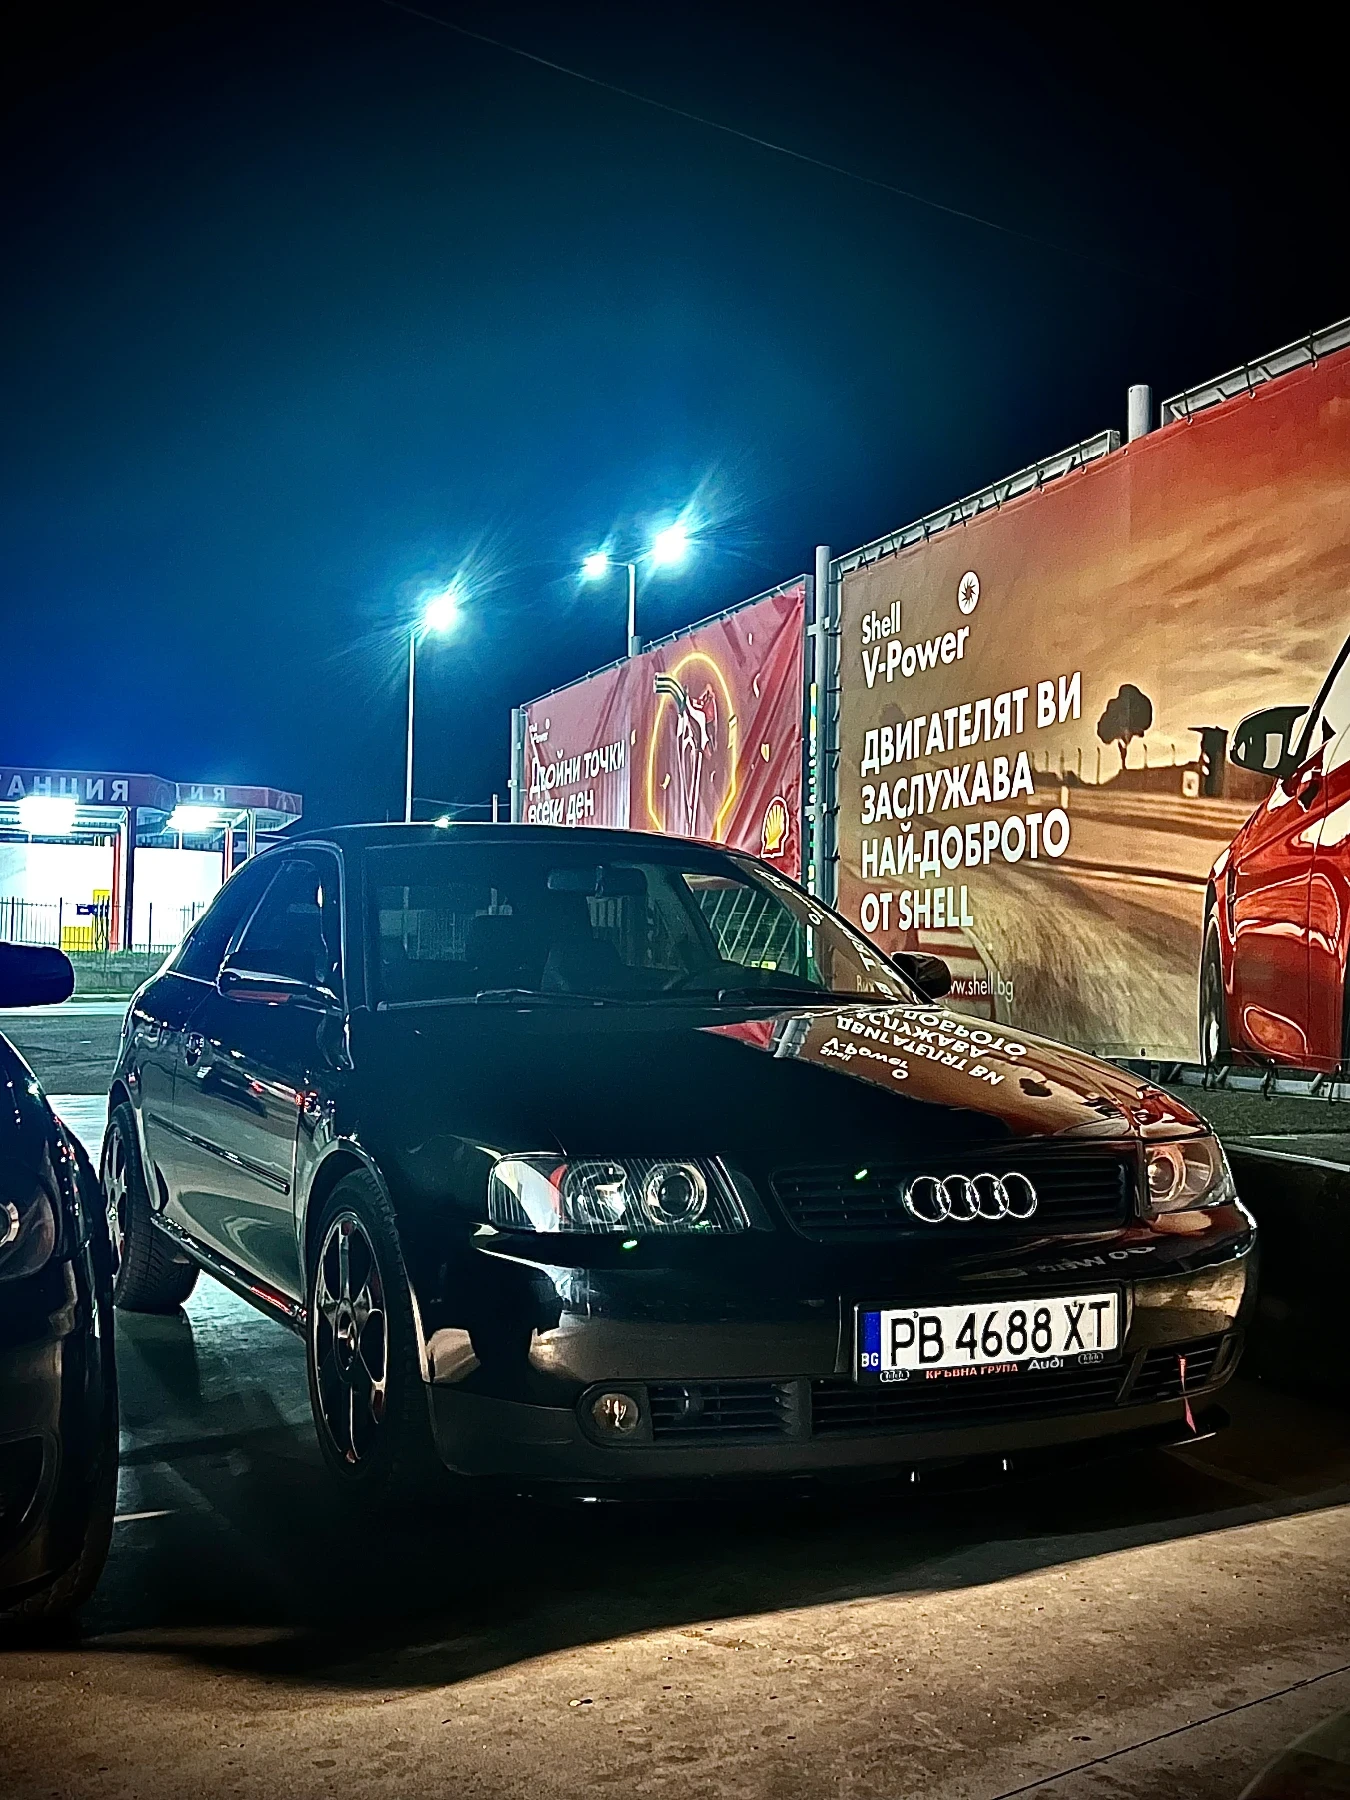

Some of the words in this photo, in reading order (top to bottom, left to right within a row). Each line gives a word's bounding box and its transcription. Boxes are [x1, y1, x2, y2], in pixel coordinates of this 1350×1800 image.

[862, 601, 902, 645] Shell
[861, 624, 970, 689] V-Power
[860, 686, 1029, 776] ДВИГАТЕЛЯТ
[1037, 671, 1082, 731] ВИ
[584, 739, 625, 779] точки
[0, 774, 129, 801] АНЦИЯ
[566, 789, 594, 827] ден
[860, 751, 1034, 825] ЗАСЛУЖАВА
[861, 808, 1070, 879] НАЙ-ДОБРОТО
[860, 892, 893, 933] ОТ
[899, 885, 974, 931] SHELL
[890, 1316, 944, 1366] PB
[955, 1307, 1052, 1360] 4688
[1063, 1301, 1110, 1350] XT
[861, 1353, 879, 1368] BG
[925, 1366, 978, 1380] КРЪВНА
[980, 1363, 1019, 1376] ГРУПА
[1027, 1356, 1064, 1371] Audi
